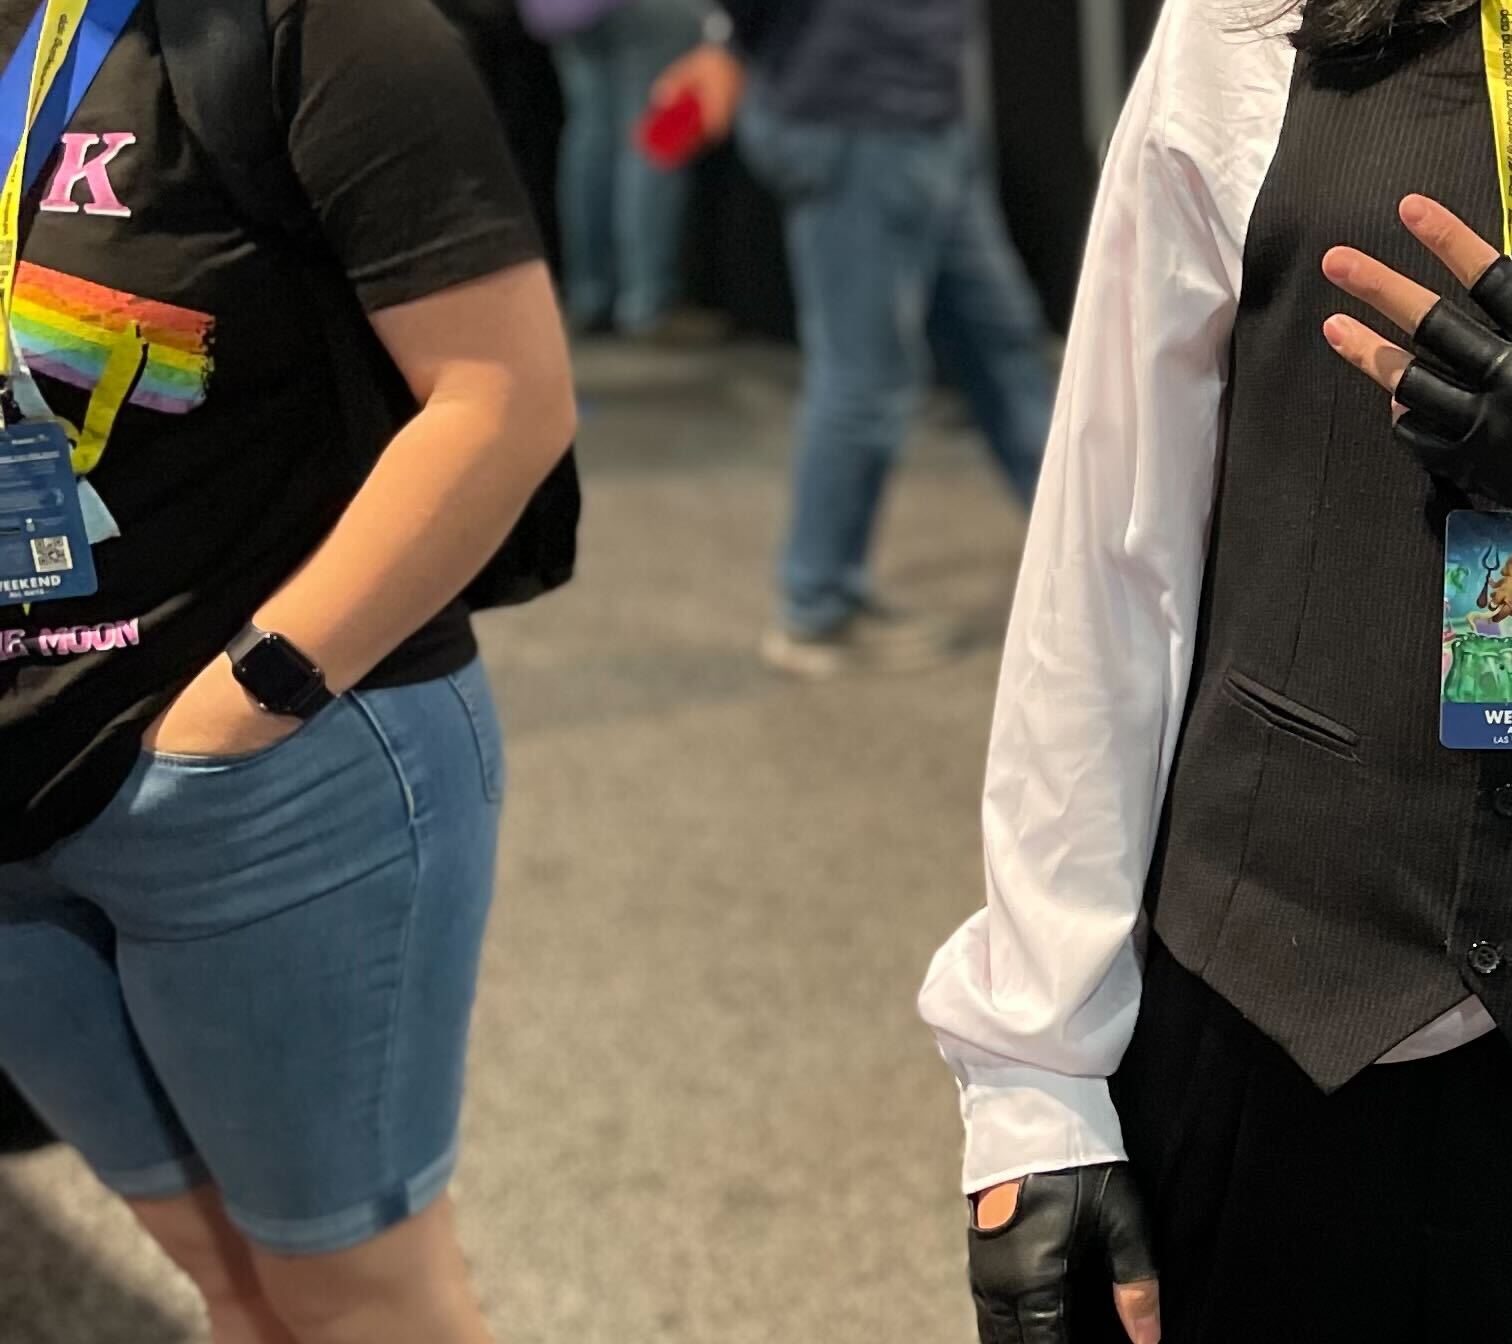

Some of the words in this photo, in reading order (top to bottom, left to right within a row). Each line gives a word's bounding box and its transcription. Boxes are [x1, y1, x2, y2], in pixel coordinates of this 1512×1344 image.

[1500, 9, 1510, 31] app
[0, 575, 61, 592] EEKEND
[38, 618, 140, 657] MOON
[1493, 736, 1510, 745] LAS
